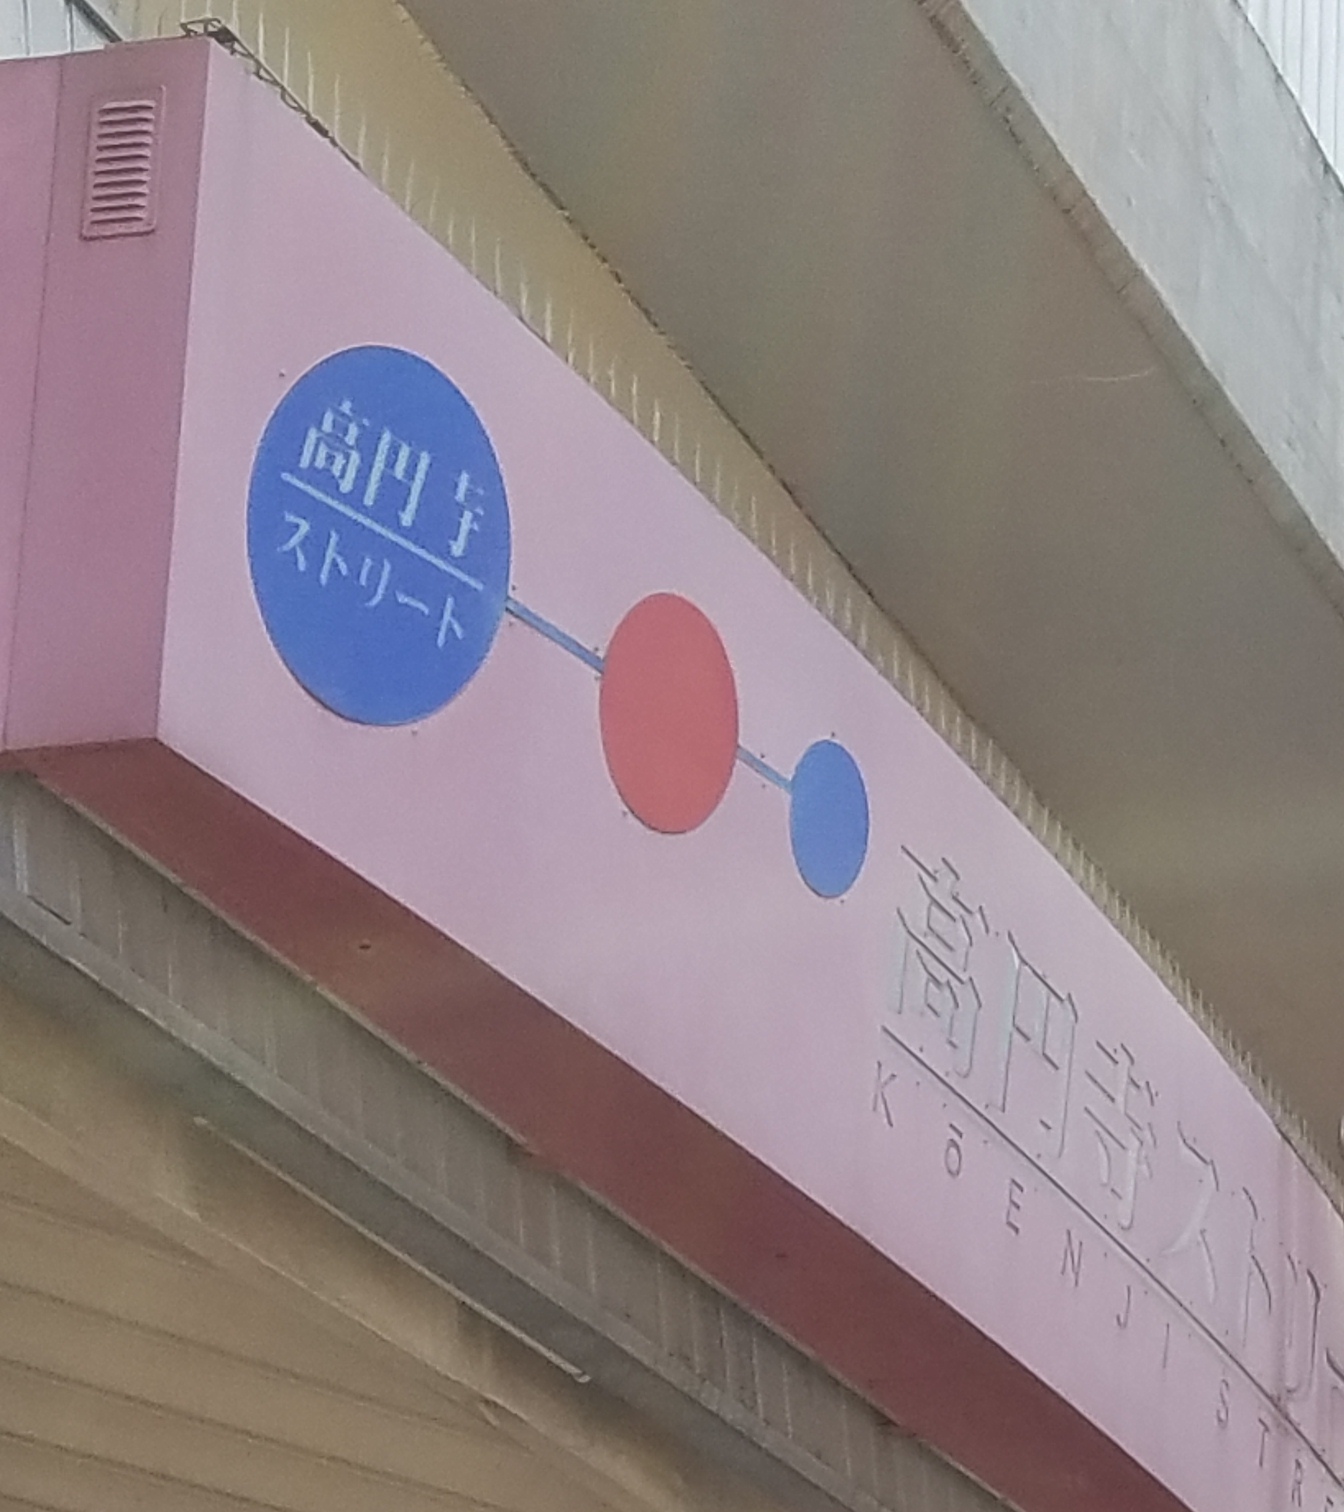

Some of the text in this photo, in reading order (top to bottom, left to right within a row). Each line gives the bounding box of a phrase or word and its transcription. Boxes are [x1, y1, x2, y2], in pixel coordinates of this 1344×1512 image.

[277, 511, 465, 648] ストリート
